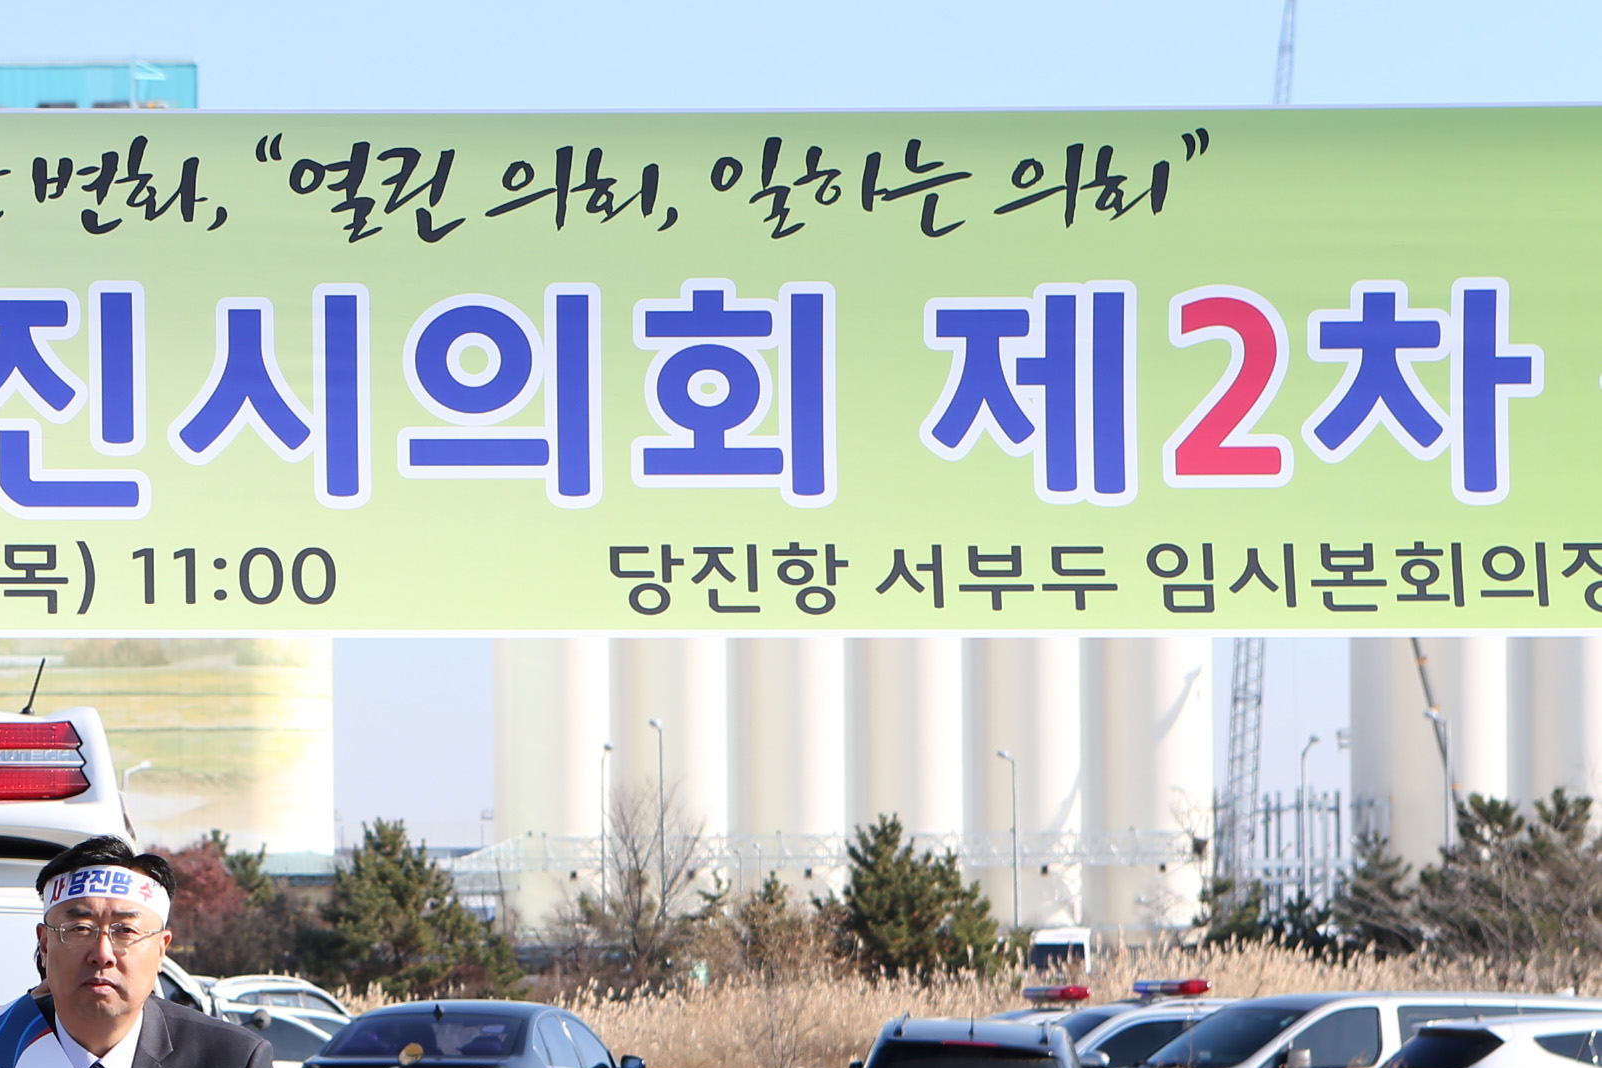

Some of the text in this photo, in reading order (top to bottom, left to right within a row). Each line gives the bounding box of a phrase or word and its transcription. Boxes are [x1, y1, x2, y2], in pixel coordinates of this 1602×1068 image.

[31, 135, 228, 235] 변화,
[484, 144, 679, 232] 의회,
[710, 136, 973, 240] 일하는
[930, 287, 1534, 495] 제2차
[132, 547, 336, 605] 11:00
[609, 542, 849, 615] 당진항
[875, 544, 1118, 611] 서부두
[68, 869, 134, 896] 당진땅
